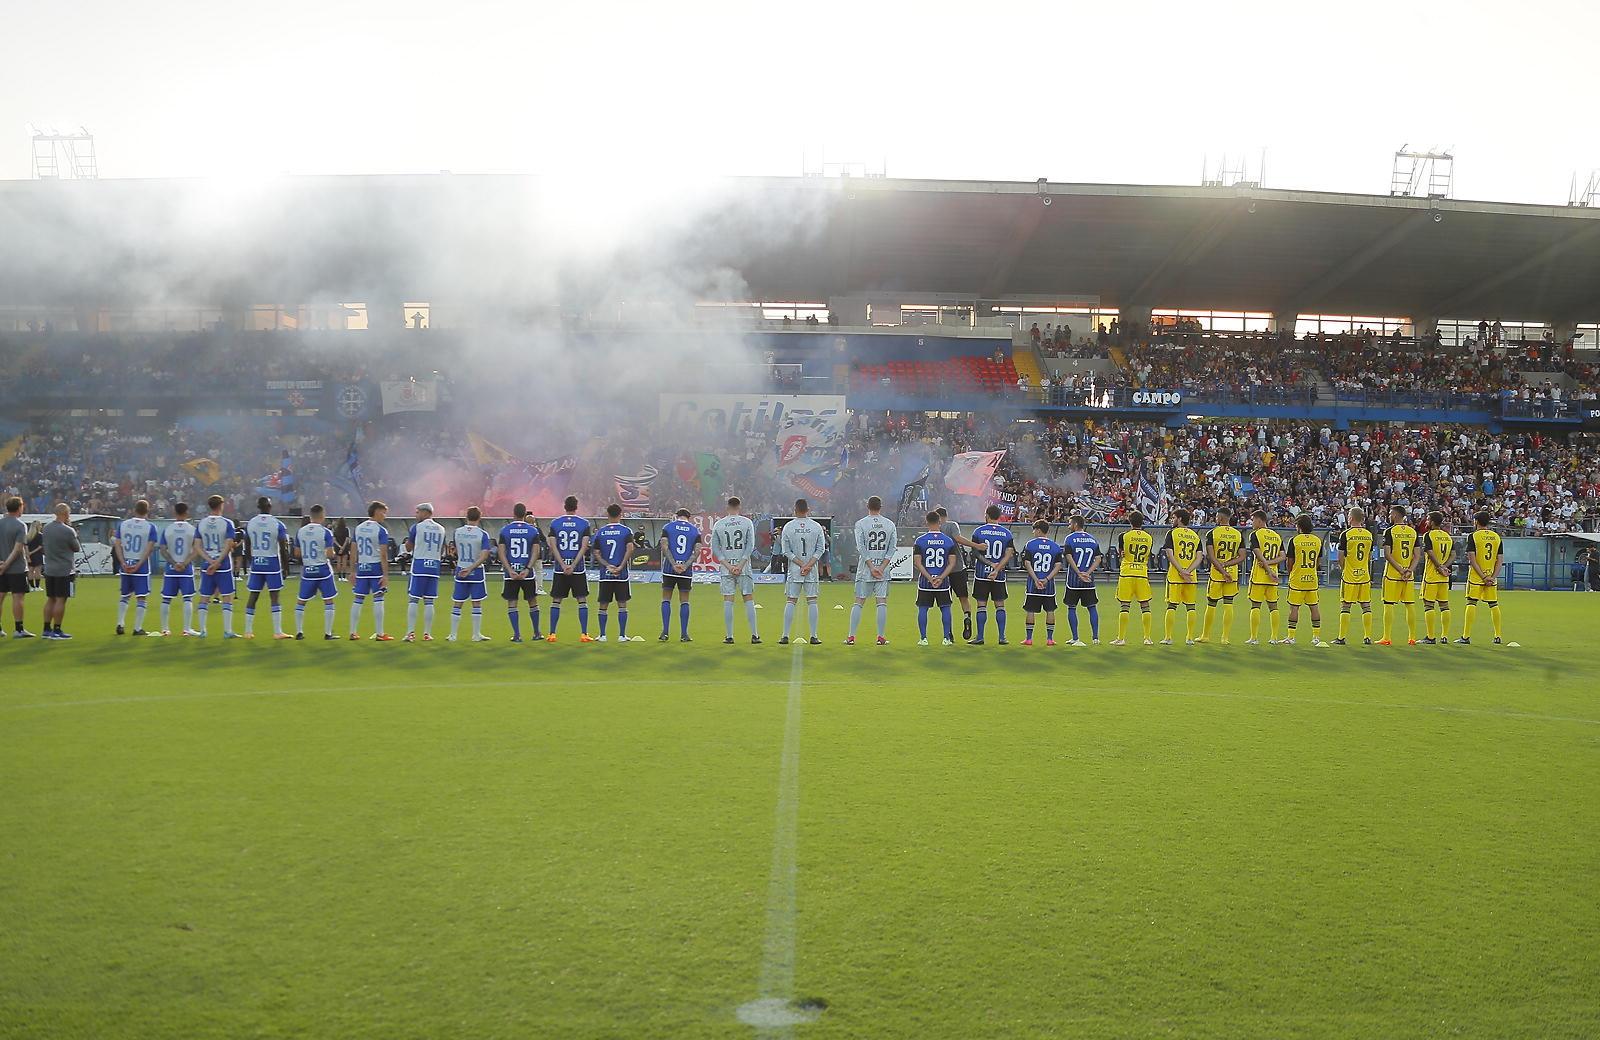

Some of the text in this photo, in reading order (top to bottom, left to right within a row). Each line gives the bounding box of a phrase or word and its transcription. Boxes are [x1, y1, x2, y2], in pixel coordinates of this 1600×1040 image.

[1132, 391, 1181, 404] CAMPO
[124, 534, 142, 553] 30
[175, 537, 183, 556] 8
[204, 532, 220, 552] 14
[253, 531, 271, 551] 15
[302, 540, 318, 560] 16
[357, 536, 372, 556] 36
[424, 532, 441, 552] 44
[510, 538, 529, 558] 51
[559, 530, 579, 551] 32
[606, 540, 616, 559] 7
[676, 534, 687, 554] 9
[724, 530, 743, 550] 12
[801, 537, 807, 557] 1
[868, 530, 887, 551] 22
[984, 540, 1003, 560] 10
[1216, 540, 1236, 560] 24
[1401, 540, 1410, 560] 5
[459, 542, 473, 562] 11
[925, 548, 944, 568] 26
[1075, 548, 1094, 568] 77
[1129, 544, 1148, 562] 42
[1178, 540, 1195, 561] 33
[1264, 541, 1278, 560] 20
[1300, 550, 1316, 568] 19
[1356, 542, 1364, 562] 6
[1440, 543, 1447, 560] 4
[1484, 542, 1493, 561] 3
[1033, 552, 1052, 572] 28
